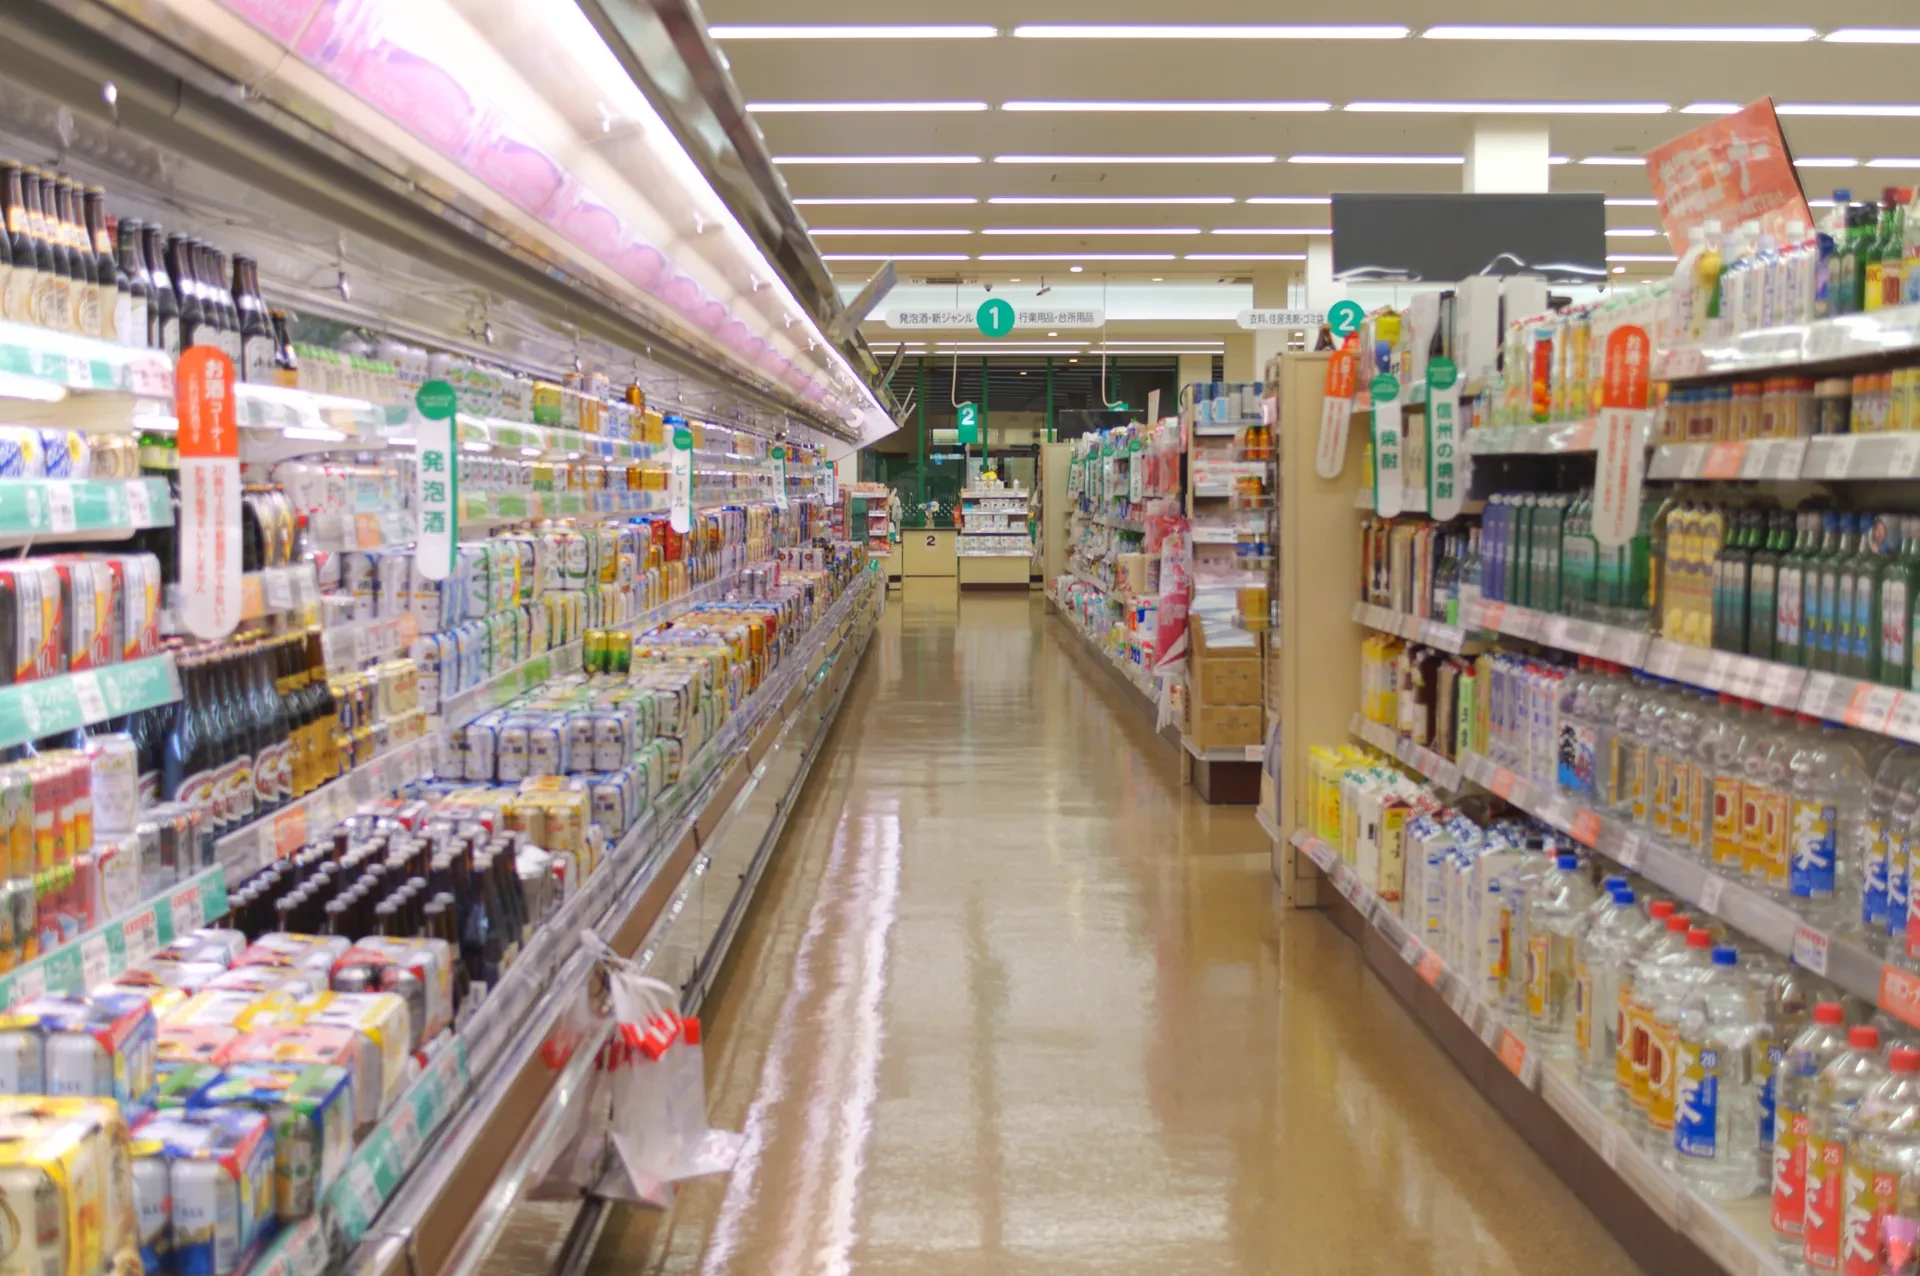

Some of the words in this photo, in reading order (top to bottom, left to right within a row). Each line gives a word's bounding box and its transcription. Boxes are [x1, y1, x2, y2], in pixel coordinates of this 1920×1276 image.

[899, 312, 974, 324] 発泡酒・新ジャンル
[988, 306, 999, 330] 1
[1018, 311, 1094, 324] 行楽用品・台所用品
[1338, 308, 1355, 331] 2
[961, 407, 975, 426] 2
[422, 449, 446, 534] 発泡酒
[926, 535, 936, 547] 2
[1700, 1052, 1717, 1068] 20
[1823, 1147, 1839, 1165] 25
[1874, 1177, 1892, 1196] 25
